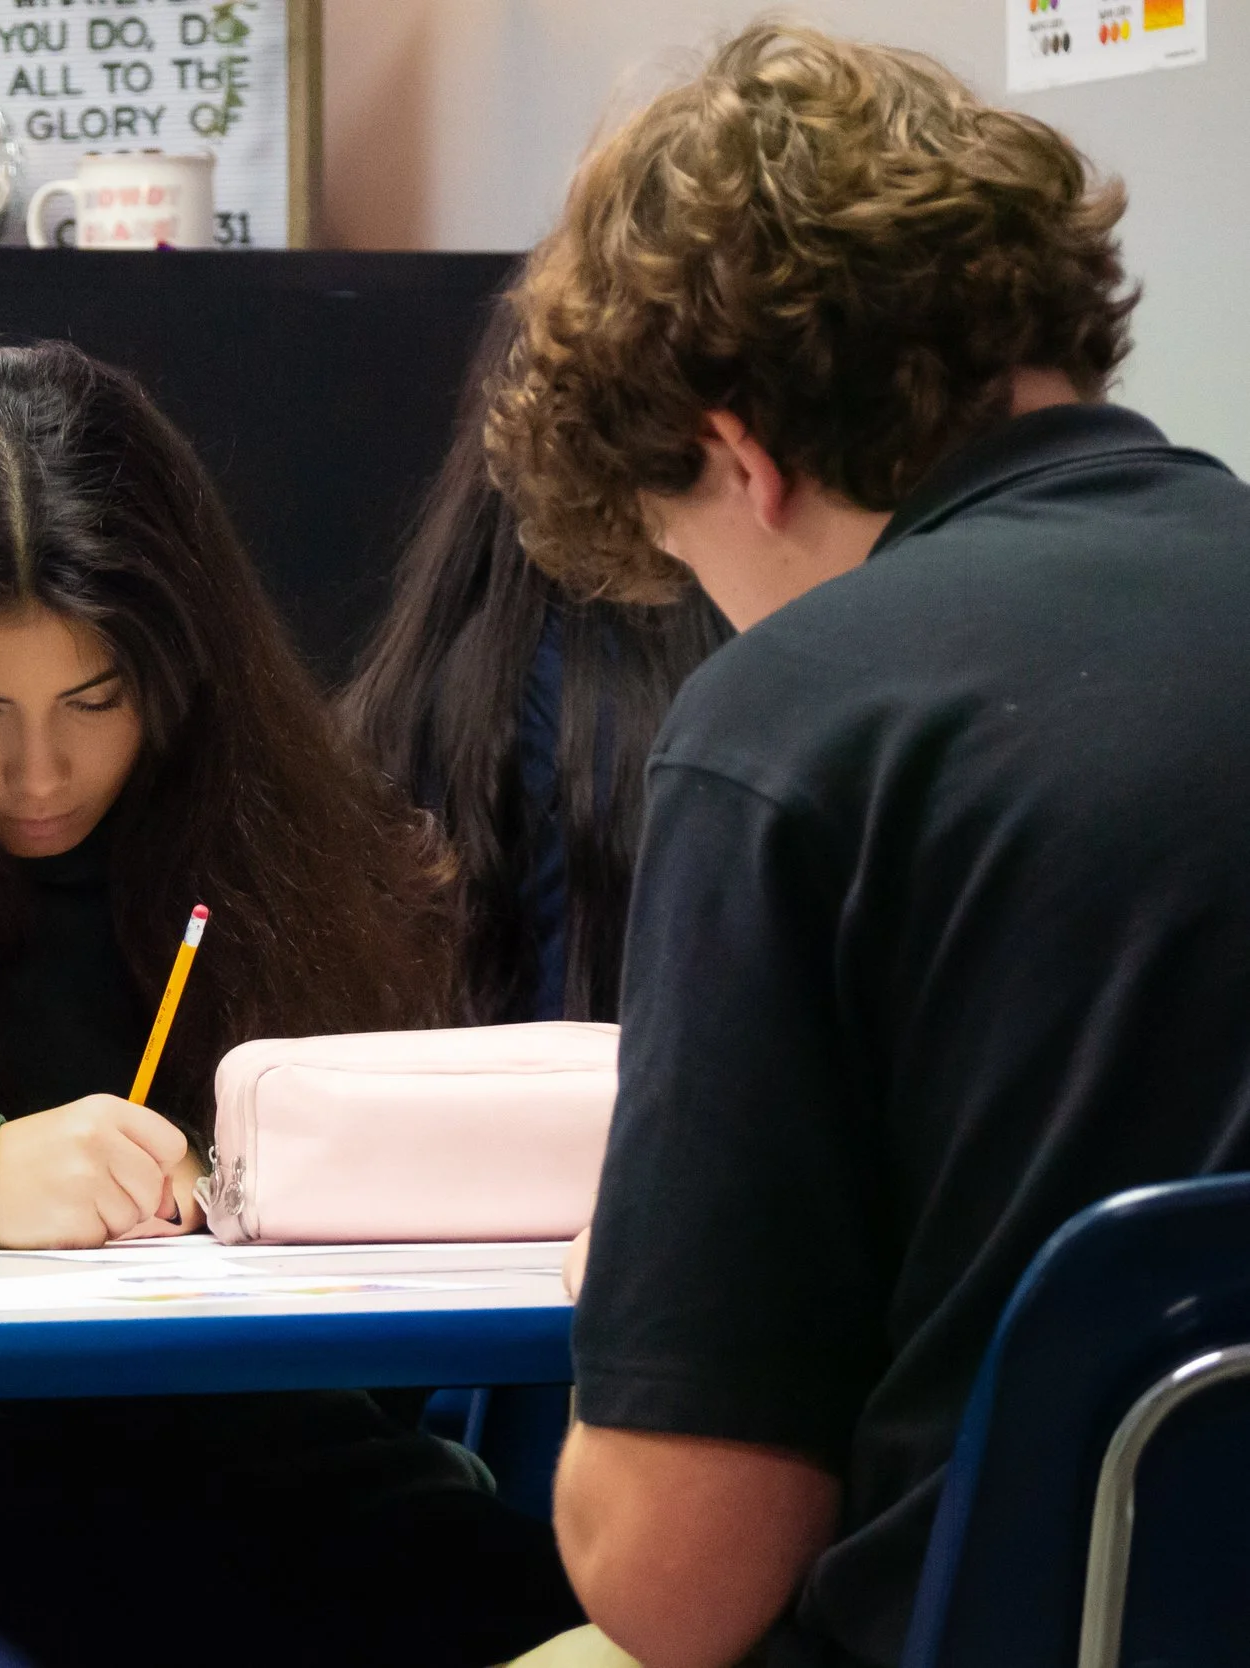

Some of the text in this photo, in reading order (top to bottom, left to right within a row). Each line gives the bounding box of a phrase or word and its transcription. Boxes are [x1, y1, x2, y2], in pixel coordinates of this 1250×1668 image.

[87, 16, 154, 52] DO,
[7, 55, 249, 96] ALL TO THE
[26, 104, 167, 140] GLORY
